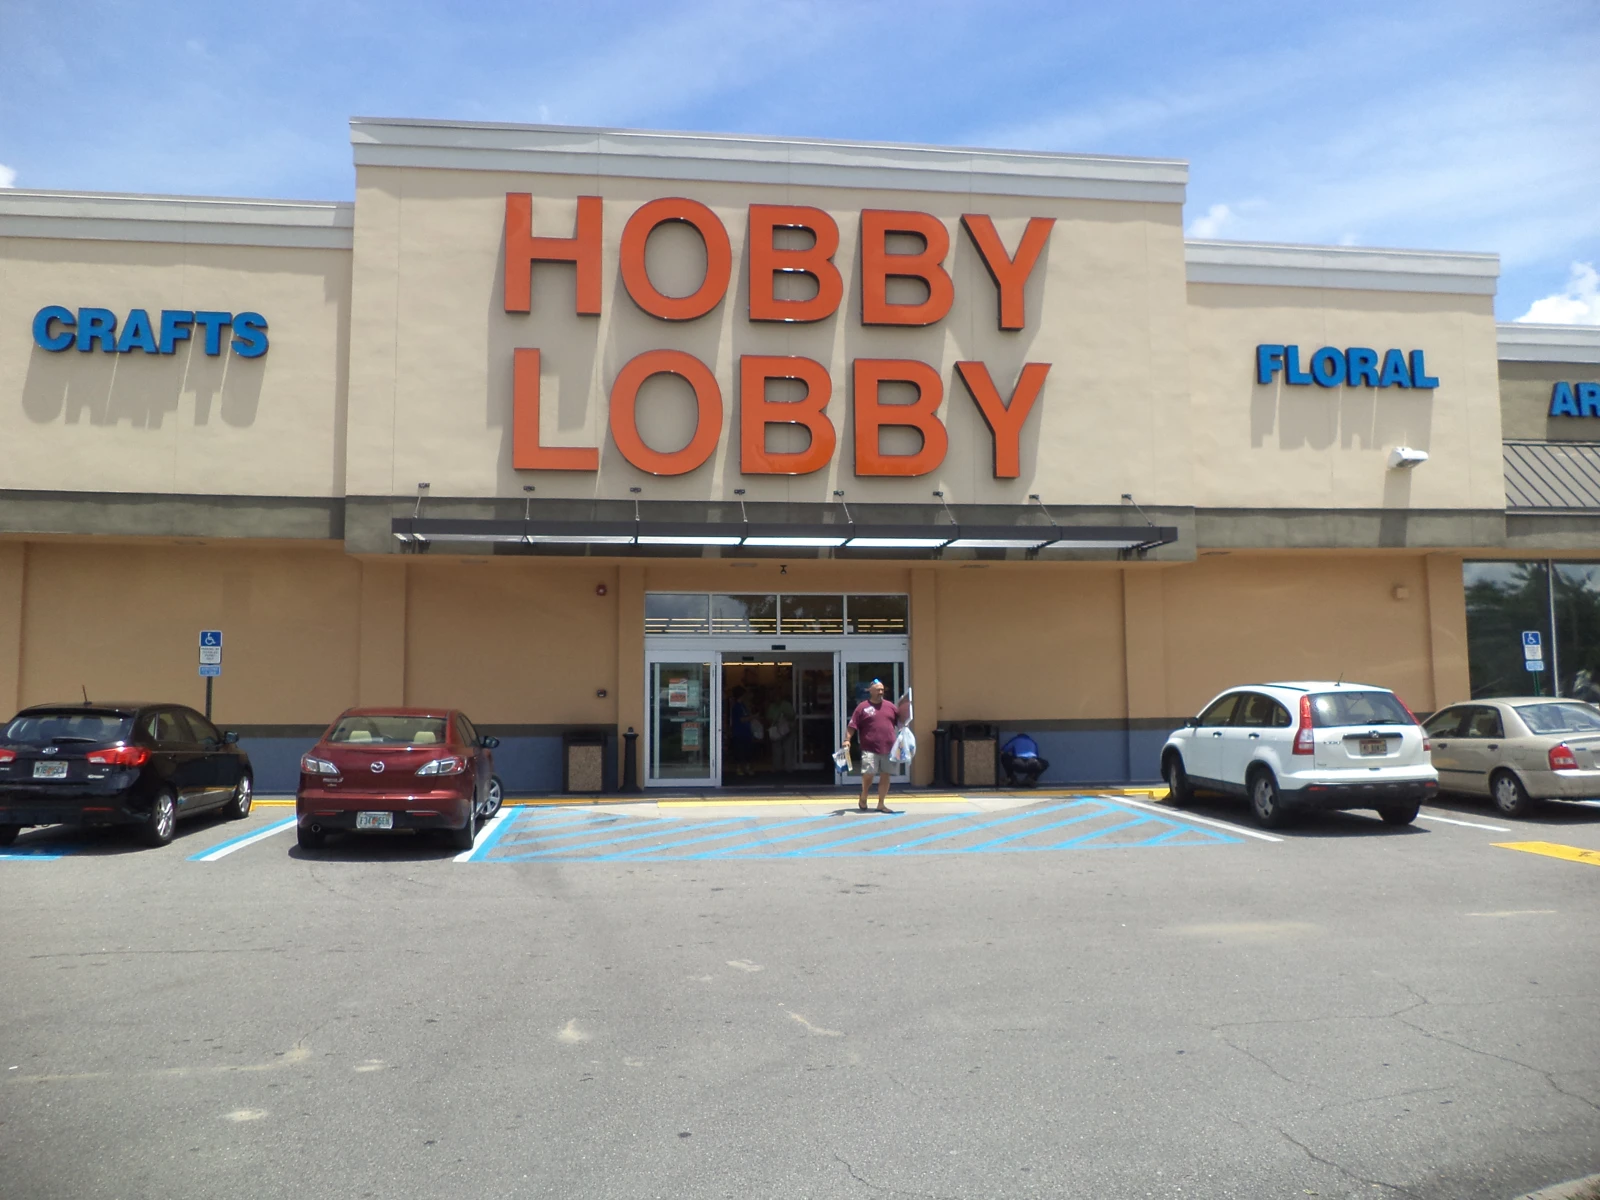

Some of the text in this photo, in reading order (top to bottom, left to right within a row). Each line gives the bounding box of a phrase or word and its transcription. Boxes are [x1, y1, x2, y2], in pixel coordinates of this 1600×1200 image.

[504, 192, 1057, 331] HOBBY
[32, 305, 269, 358] CRAFTS
[1256, 344, 1440, 389] FLORAL
[513, 348, 1053, 479] LOBBY
